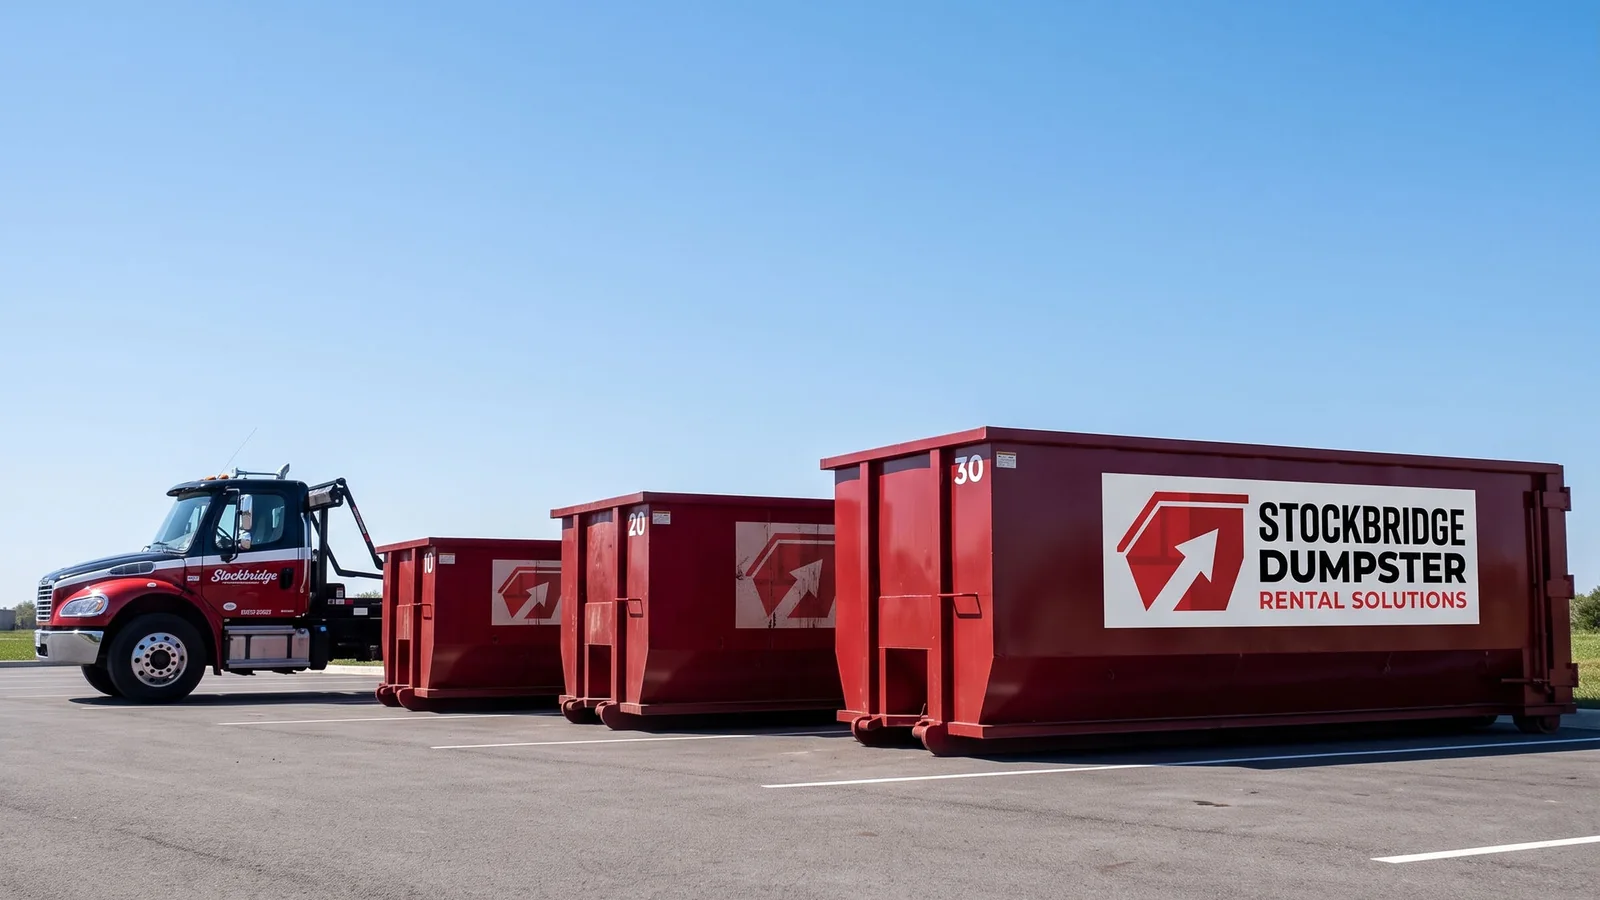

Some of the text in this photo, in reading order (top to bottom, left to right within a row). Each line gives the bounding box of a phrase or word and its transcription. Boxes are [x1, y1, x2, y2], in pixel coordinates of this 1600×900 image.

[954, 454, 984, 485] 30
[628, 511, 645, 537] 20
[1259, 502, 1466, 546] STOCKBRIDGE
[424, 552, 433, 574] 10
[1259, 549, 1467, 583] DUMPSTER
[211, 569, 277, 584] Stockbridge
[1259, 591, 1467, 609] RENTAL SOLUTIONS
